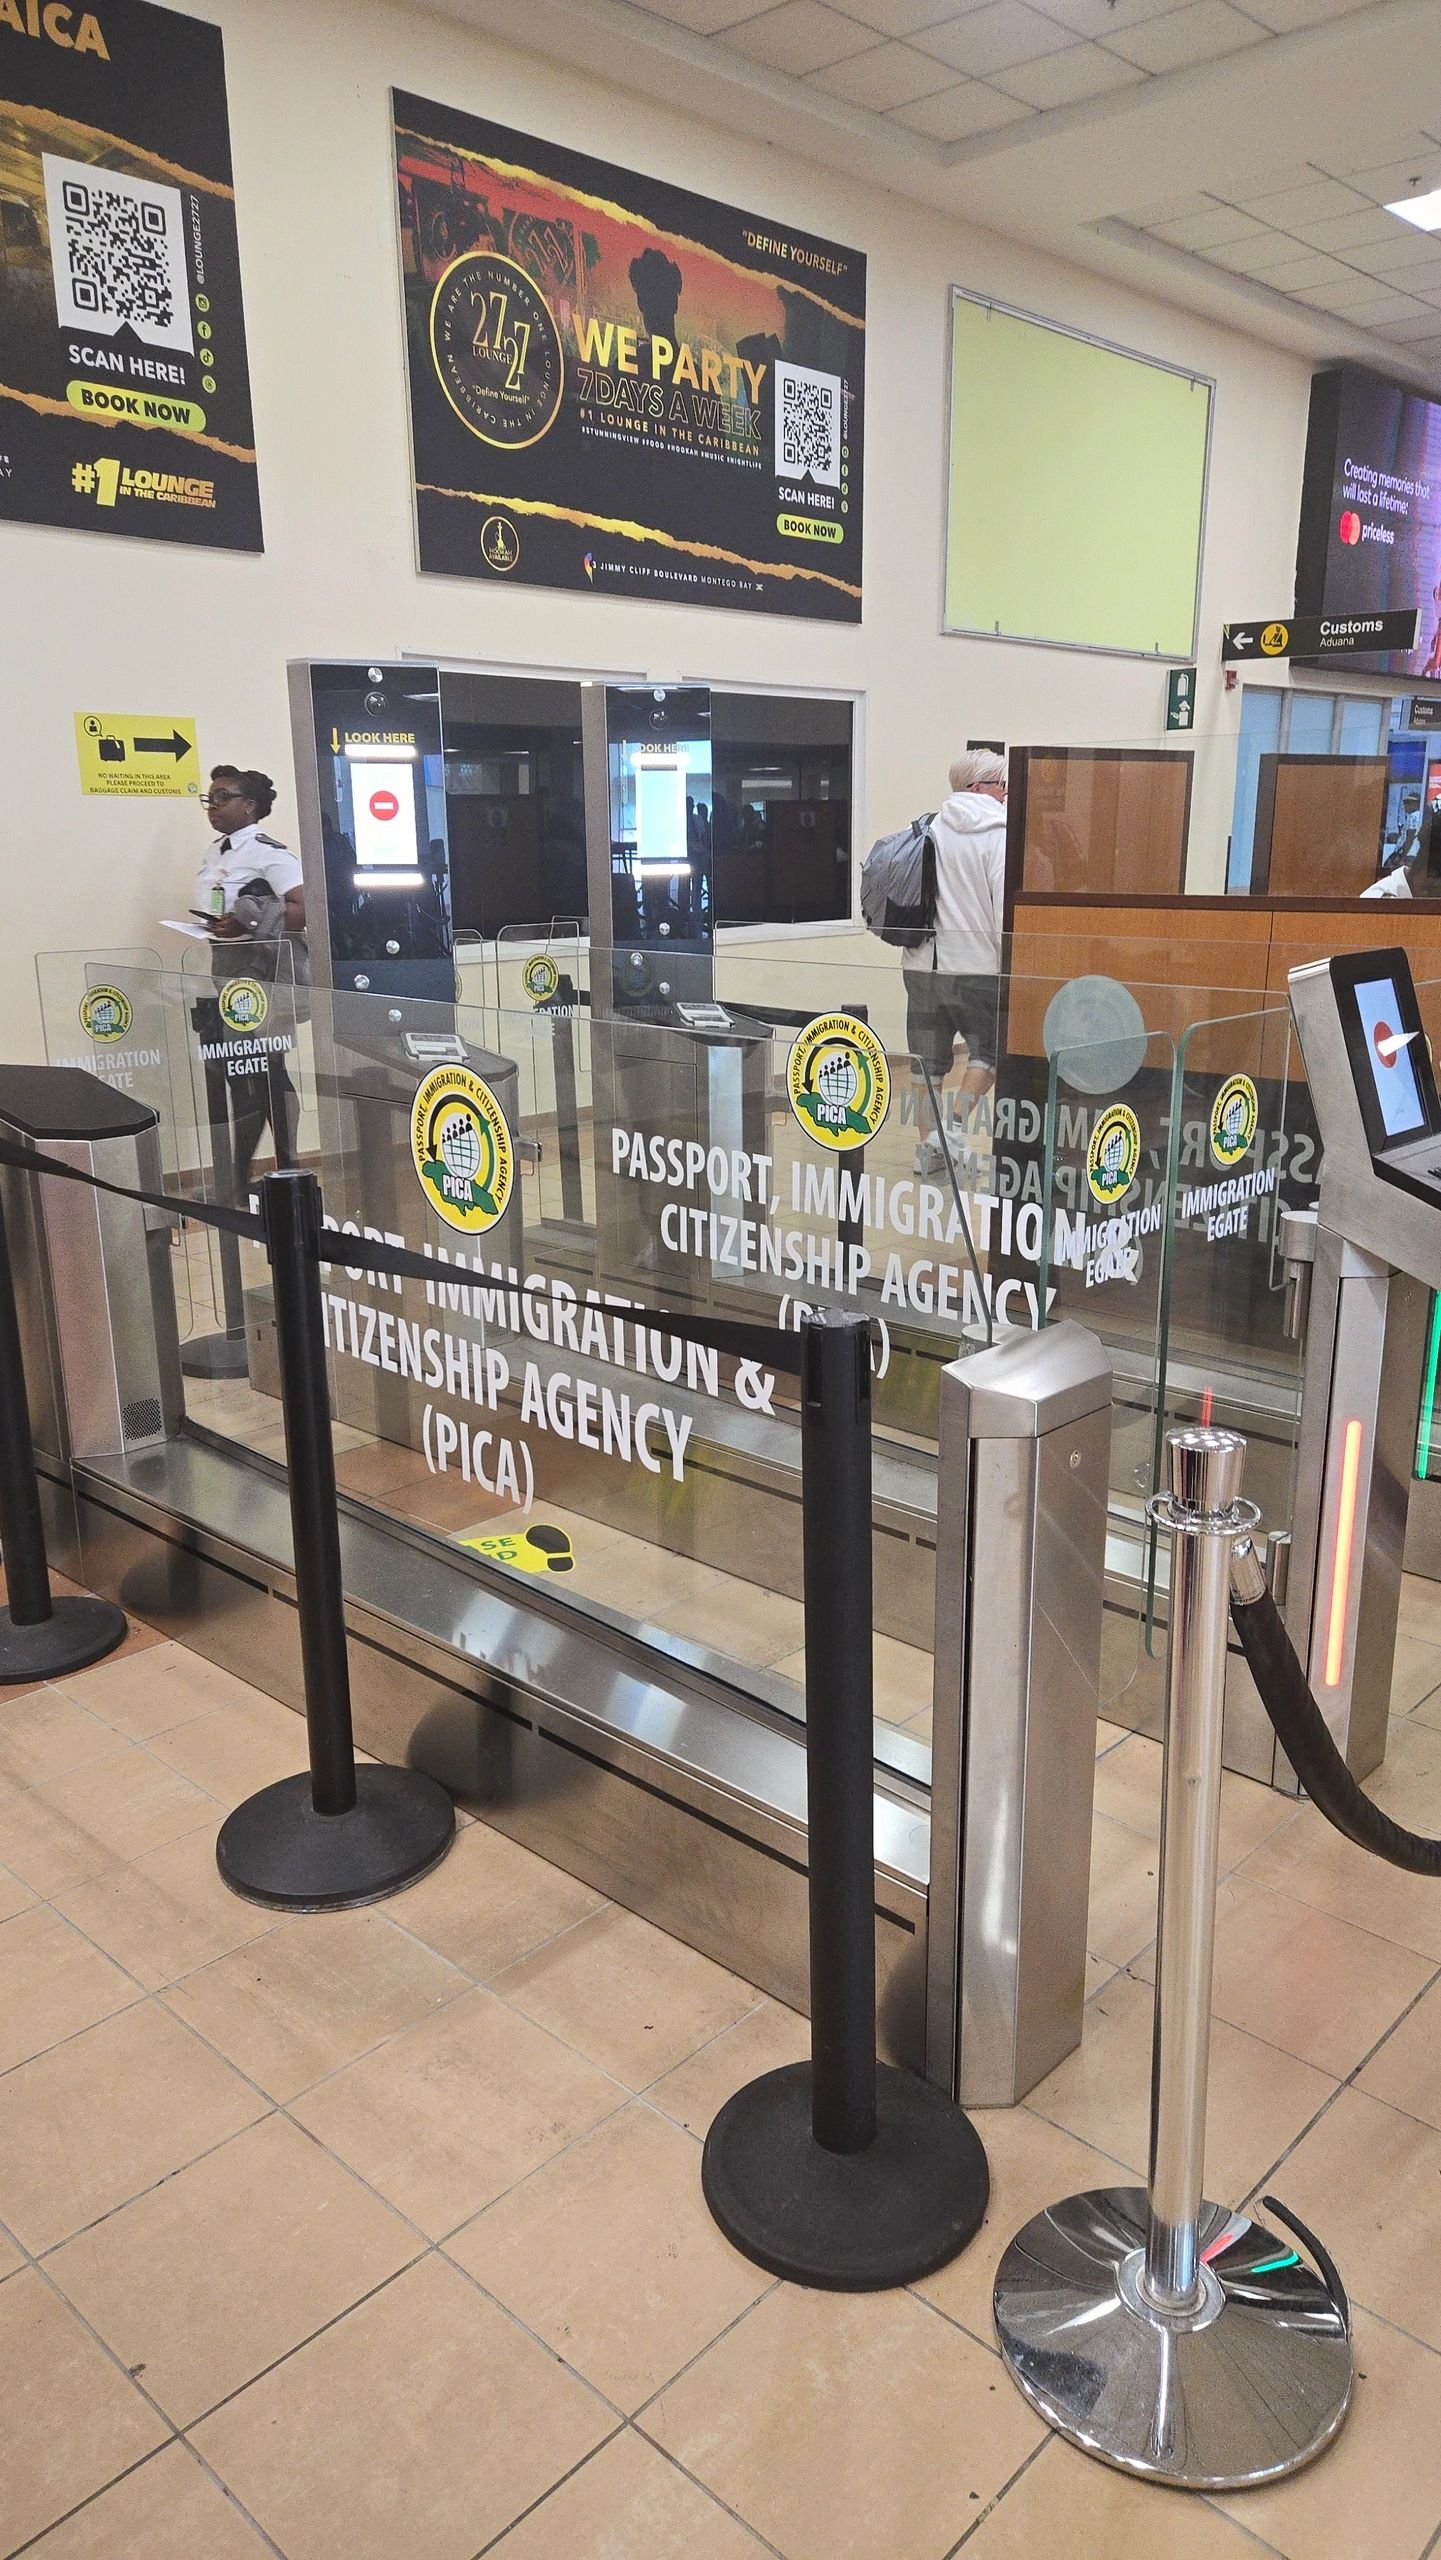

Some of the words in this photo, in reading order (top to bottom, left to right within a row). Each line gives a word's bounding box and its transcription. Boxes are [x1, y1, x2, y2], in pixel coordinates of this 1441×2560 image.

[190, 195, 205, 284] @LOUNGE2727
[742, 229, 788, 258] "DEFINE
[790, 245, 848, 276] YOURSELF"
[463, 271, 482, 287] THE
[488, 271, 530, 306] NUMBER
[450, 287, 462, 314] ARE
[445, 321, 452, 341] WE
[533, 311, 547, 341] ONE
[68, 344, 124, 373] SCAN
[129, 356, 186, 385] HERE!
[472, 346, 512, 365] LOUNGE
[572, 312, 639, 375] WE
[651, 334, 767, 405] PARTY
[448, 354, 496, 425] CARIBBEAN
[537, 351, 552, 408] LOUNGE
[81, 388, 140, 415] BOOK
[144, 402, 190, 424] NOW
[472, 384, 498, 399] "Define
[499, 390, 530, 405] Yourself"
[502, 418, 522, 428] THE
[525, 409, 537, 422] IN
[669, 391, 688, 424] A
[692, 394, 762, 441] WEEK
[579, 407, 593, 422] #1
[600, 412, 648, 433] LOUNGE
[654, 423, 667, 437] IN
[671, 427, 693, 442] THE
[697, 433, 760, 457] CARIBBEAN
[582, 425, 639, 445] #STUNNINGVIEW
[642, 438, 665, 450] #FOOD
[667, 443, 699, 457] #HOOKAH
[701, 450, 725, 462] #MUSIC
[726, 456, 762, 470] #NIGHTLIFE
[71, 457, 120, 507] #1
[121, 467, 214, 498] LOUNGE
[1344, 458, 1377, 488] Creating
[1378, 473, 1414, 495] memories
[1415, 480, 1430, 499] that
[119, 485, 132, 496] IN
[134, 488, 154, 499] THE
[156, 491, 216, 508] CARIBBEAN
[778, 486, 805, 505] SCAN
[807, 492, 835, 510] HERE!
[1343, 482, 1356, 500] will
[1356, 485, 1372, 505] last
[1372, 493, 1378, 506] a
[1379, 489, 1409, 515] lifetime:
[784, 519, 811, 535] BOOK
[814, 524, 836, 539] NOW
[1362, 521, 1395, 545] priceless
[600, 562, 626, 573] JIMMY
[629, 566, 651, 576] CLIFF
[654, 569, 698, 583] BOULEVARD
[700, 576, 736, 588] MONTEGO
[739, 581, 752, 590] BAY
[1319, 636, 1355, 648] Aduana
[1320, 620, 1384, 636] Customs
[344, 732, 381, 744] LOOK
[382, 732, 416, 744] HERE
[640, 743, 662, 753] OOK
[234, 1013, 249, 1022] PICA
[851, 1025, 856, 1035] &
[197, 1034, 293, 1061] IMMIGRATION
[804, 1020, 850, 1046] IMMIGRATION
[227, 1057, 268, 1077] EGATE
[792, 1046, 807, 1095] PASSPORT,
[858, 1030, 883, 1083] CITIZENSHIP
[1220, 1078, 1243, 1100] IMMIGRATION
[1245, 1079, 1256, 1114] CITIZENSHIP
[817, 1103, 847, 1125] PICA
[869, 1087, 884, 1124] AGENCY
[1121, 1108, 1126, 1116] &
[1097, 1108, 1122, 1135] IMMIGRATION
[1126, 1111, 1138, 1146] CITIZENSHIP
[1247, 1114, 1256, 1140] AGENCY
[423, 1072, 467, 1104] IMMIGRATION
[468, 1080, 474, 1092] &
[476, 1087, 507, 1153] CITIZENSHIP
[494, 1157, 508, 1204] AGENCY
[1223, 1135, 1238, 1149] PICA
[1128, 1147, 1138, 1176] AGENCY
[442, 1174, 474, 1202] PICA
[1101, 1172, 1118, 1187] PICA
[1181, 1168, 1275, 1219] IMMIGRATION
[612, 1127, 780, 1215] PASSPORT,
[791, 1161, 1084, 1270] IMMIGRATION
[1056, 1204, 1161, 1262] MIGTION
[1207, 1206, 1249, 1242] EGATE
[660, 1203, 872, 1296] CITIZENSHIP
[881, 1252, 1057, 1332] AGENCY
[423, 1243, 718, 1397] IMMIGRATION
[735, 1356, 775, 1416] &
[321, 1291, 510, 1412] ITIZENSHIP
[520, 1362, 693, 1483] AGENCY
[422, 1404, 534, 1515] (PICA)
